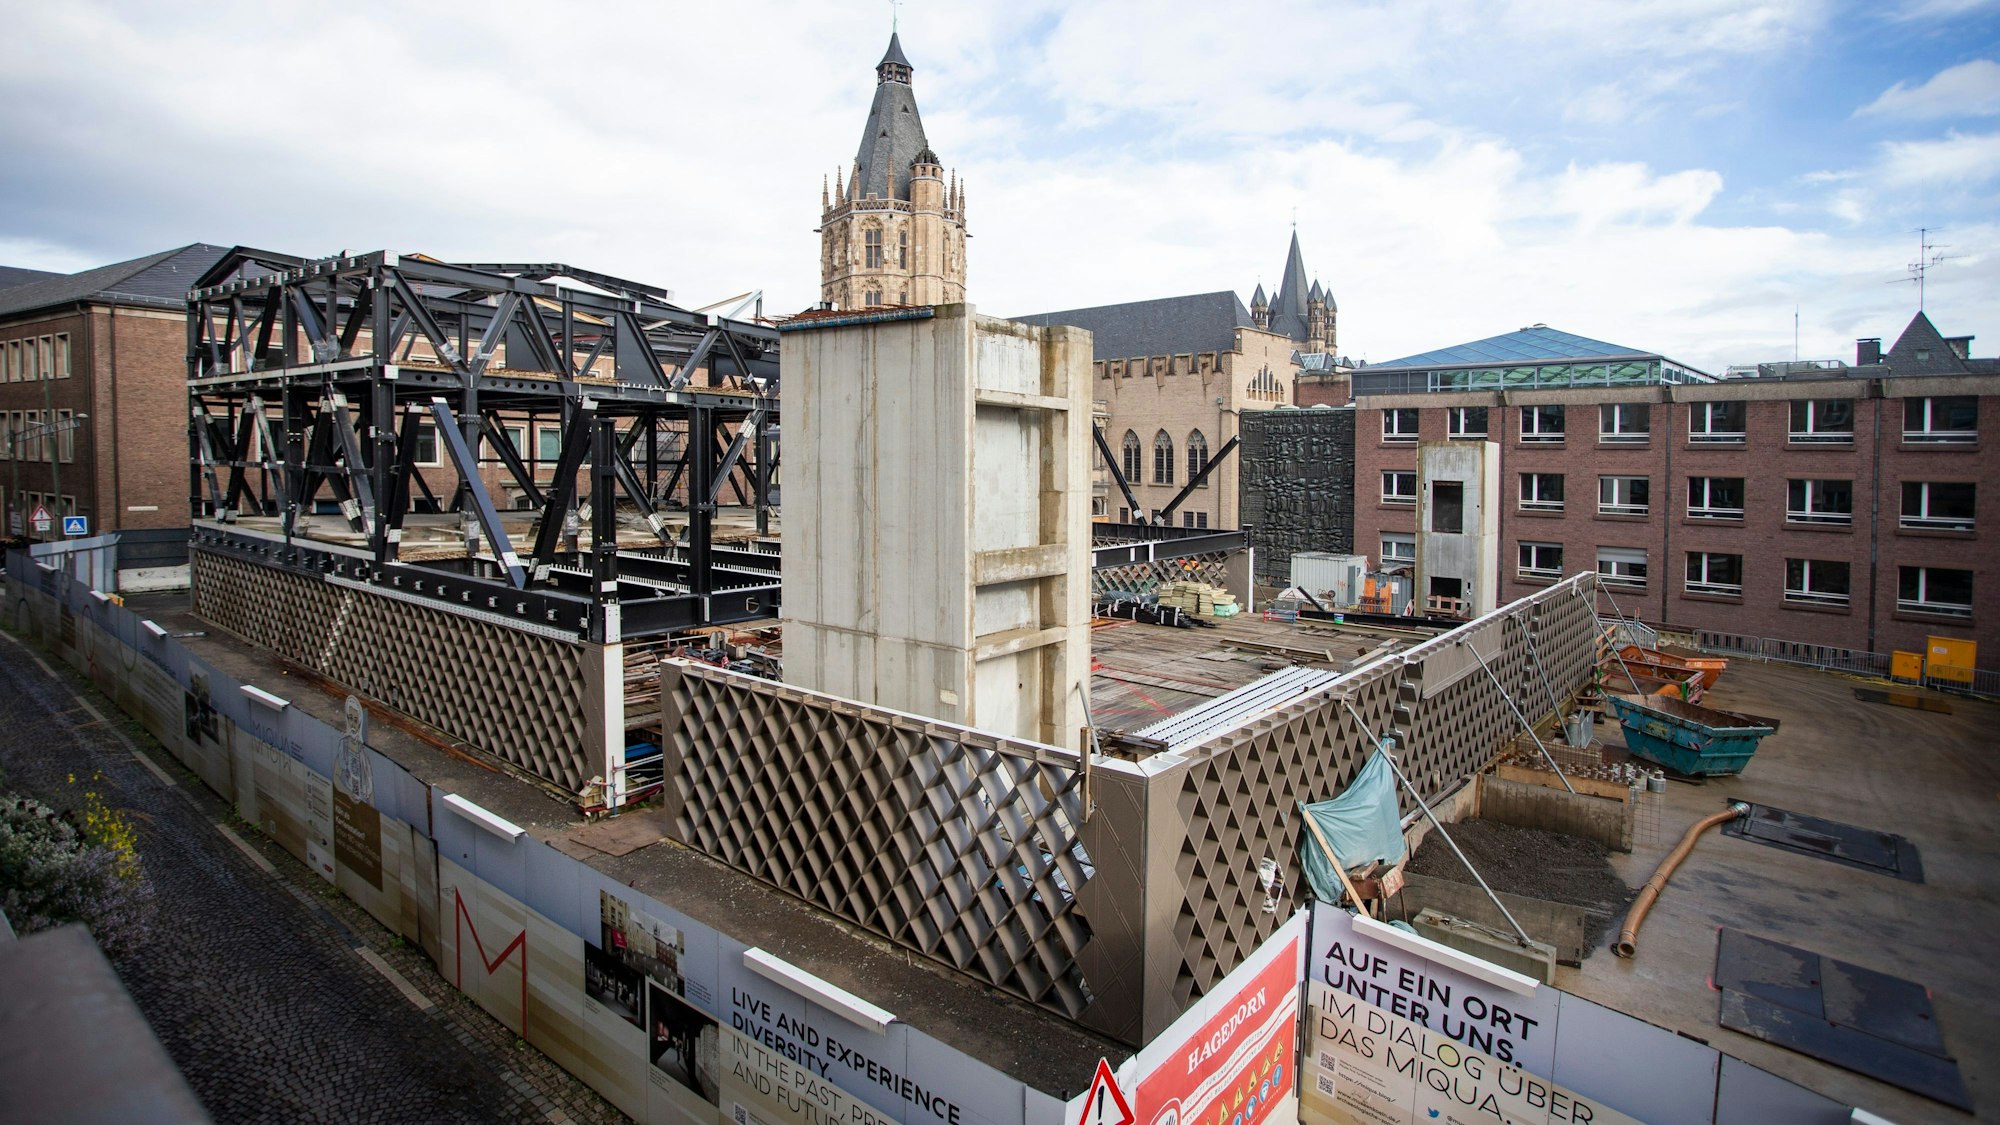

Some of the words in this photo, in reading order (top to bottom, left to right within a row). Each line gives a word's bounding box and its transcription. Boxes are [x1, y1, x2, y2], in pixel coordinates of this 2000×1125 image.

[1187, 987, 1266, 1075] HAGEDORN
[1324, 964, 1429, 1028] UNTER
[1443, 1013, 1522, 1068] UNS.
[1326, 941, 1388, 978] AUF
[1399, 967, 1451, 1008] EIN
[1463, 996, 1538, 1041] ORT
[733, 1011, 832, 1083] DIVERSITY.
[733, 987, 770, 1023] LIVE
[776, 1013, 819, 1047] AND
[827, 1037, 960, 1125] EXPERIENCE
[733, 1035, 748, 1059] IN
[754, 1046, 789, 1083] THE
[795, 1070, 845, 1120] PAST,
[733, 1061, 770, 1094] AND
[1320, 1016, 1374, 1058] DAS
[1386, 1046, 1511, 1125] MIQUA.
[1322, 990, 1356, 1024] IM
[1368, 1010, 1485, 1080] DIALOG
[1498, 1065, 1593, 1125] ÜBER
